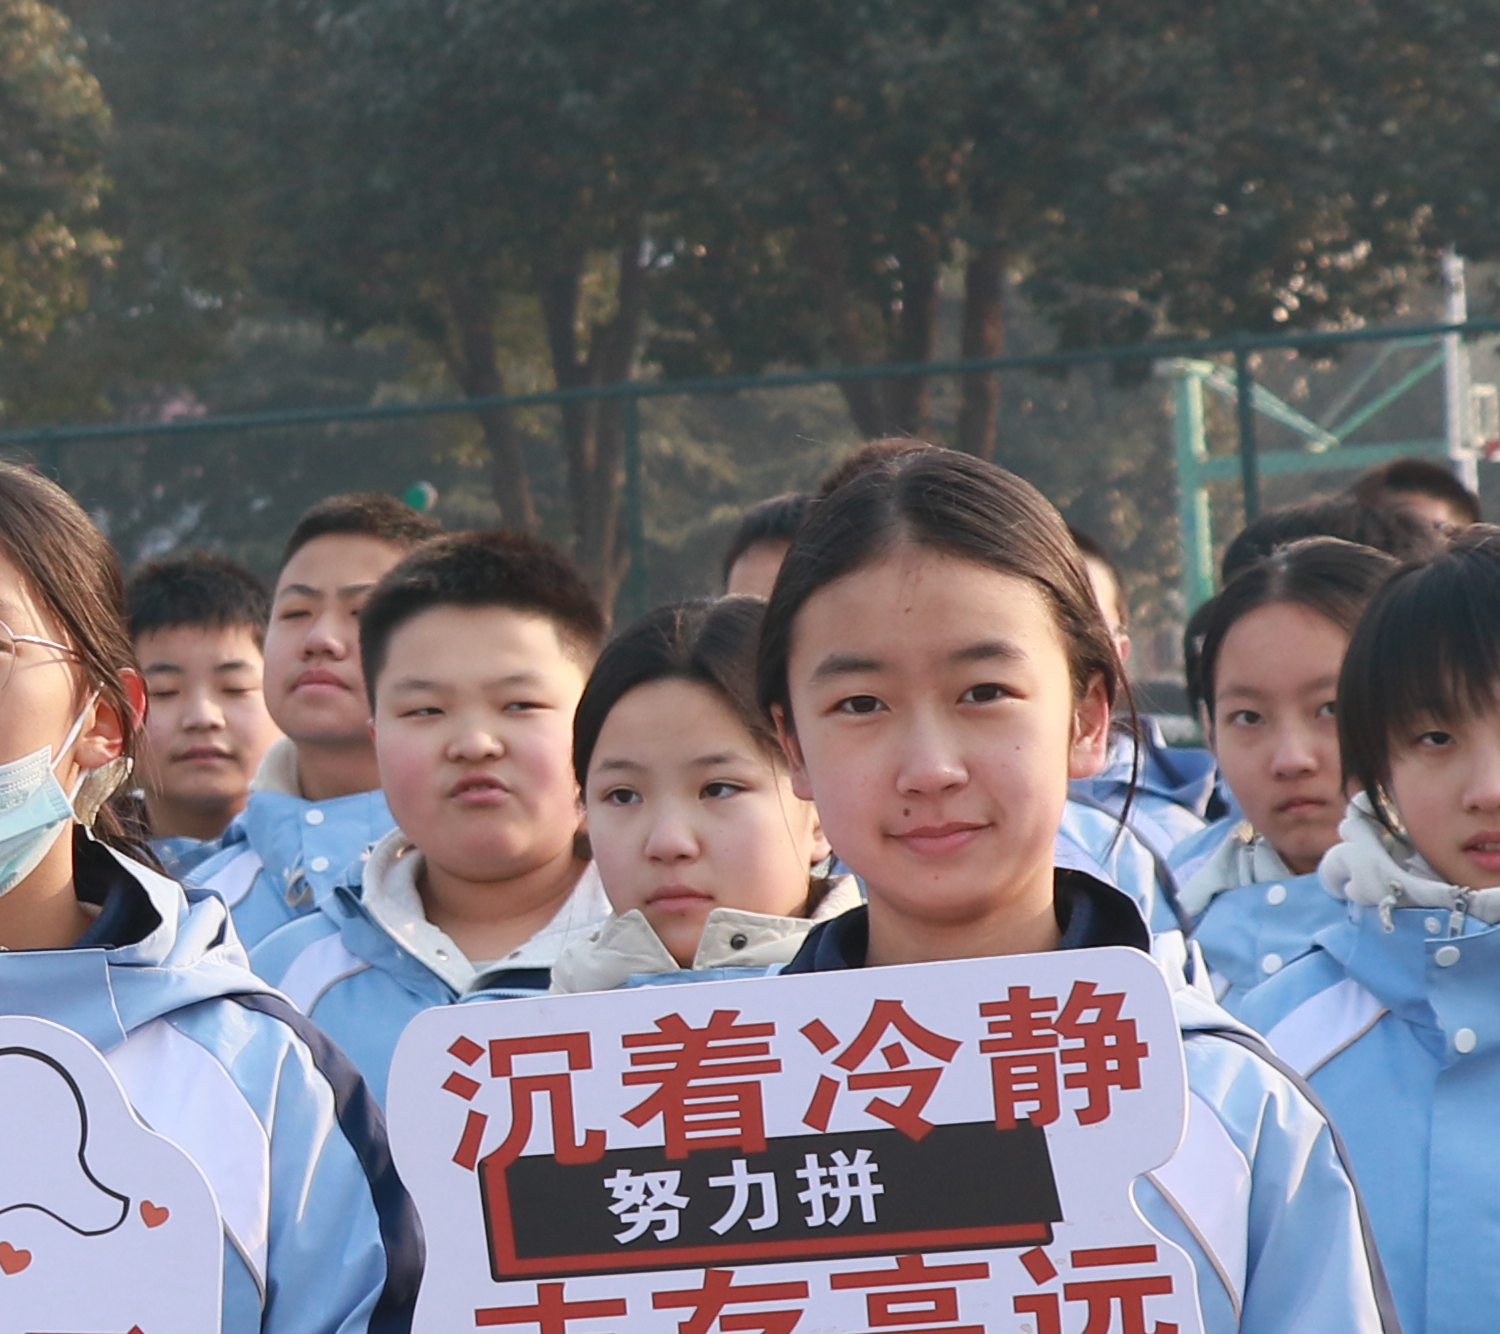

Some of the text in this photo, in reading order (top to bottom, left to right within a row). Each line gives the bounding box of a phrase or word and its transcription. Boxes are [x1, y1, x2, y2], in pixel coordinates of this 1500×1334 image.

[440, 980, 1149, 1172] 沉着冷静
[602, 1148, 885, 1244] 努力拼
